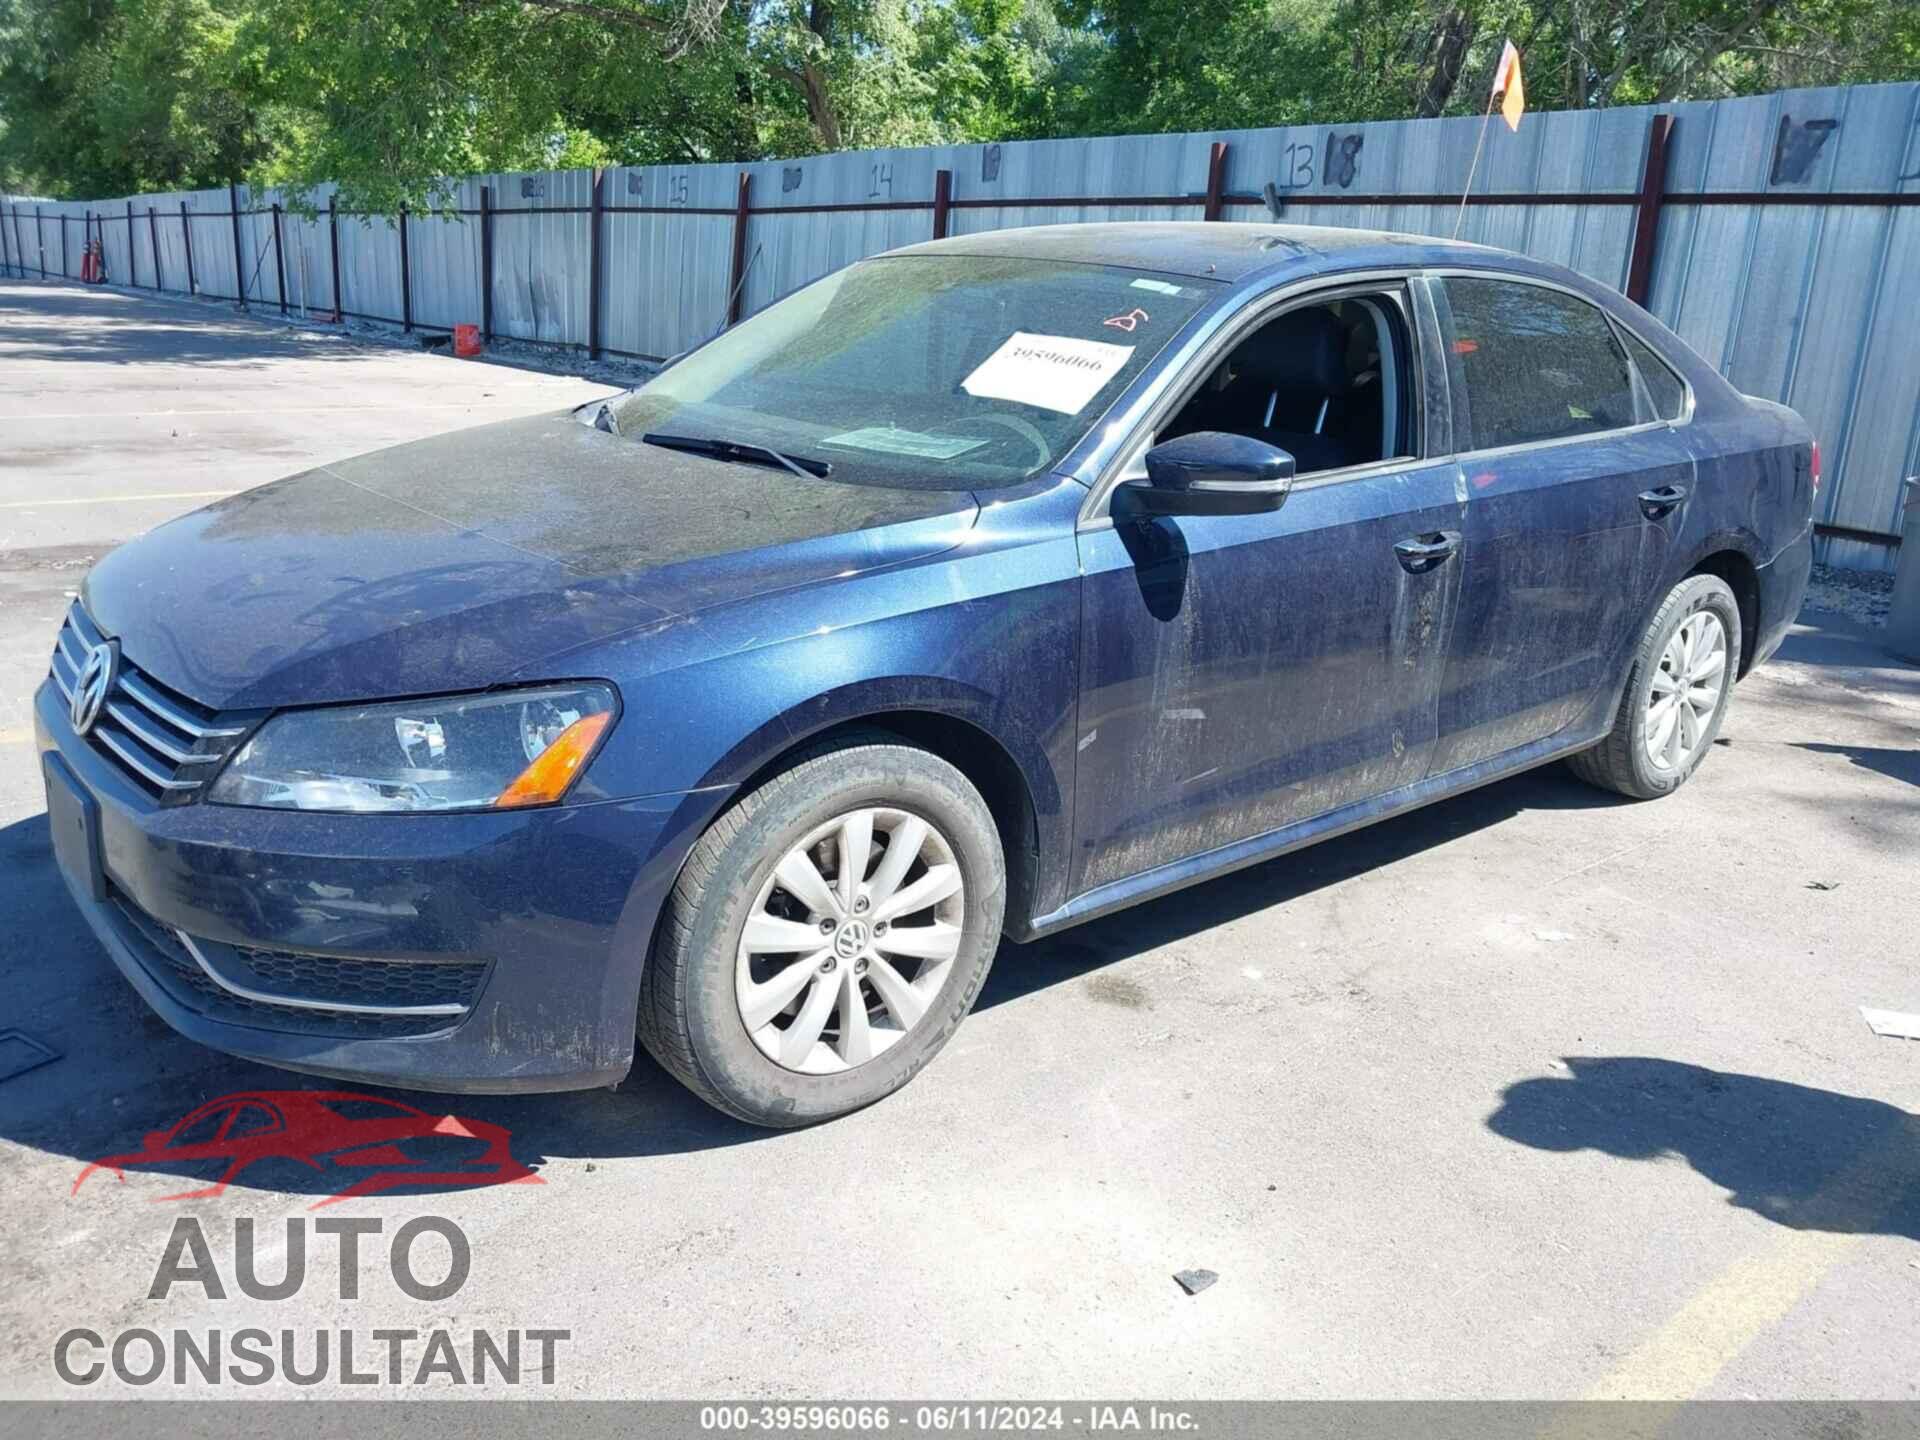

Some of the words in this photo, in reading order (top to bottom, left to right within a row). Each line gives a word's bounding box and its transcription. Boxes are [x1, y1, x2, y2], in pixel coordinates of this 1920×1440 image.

[868, 163, 894, 198] 14
[1279, 141, 1314, 189] 13
[670, 175, 689, 204] 15
